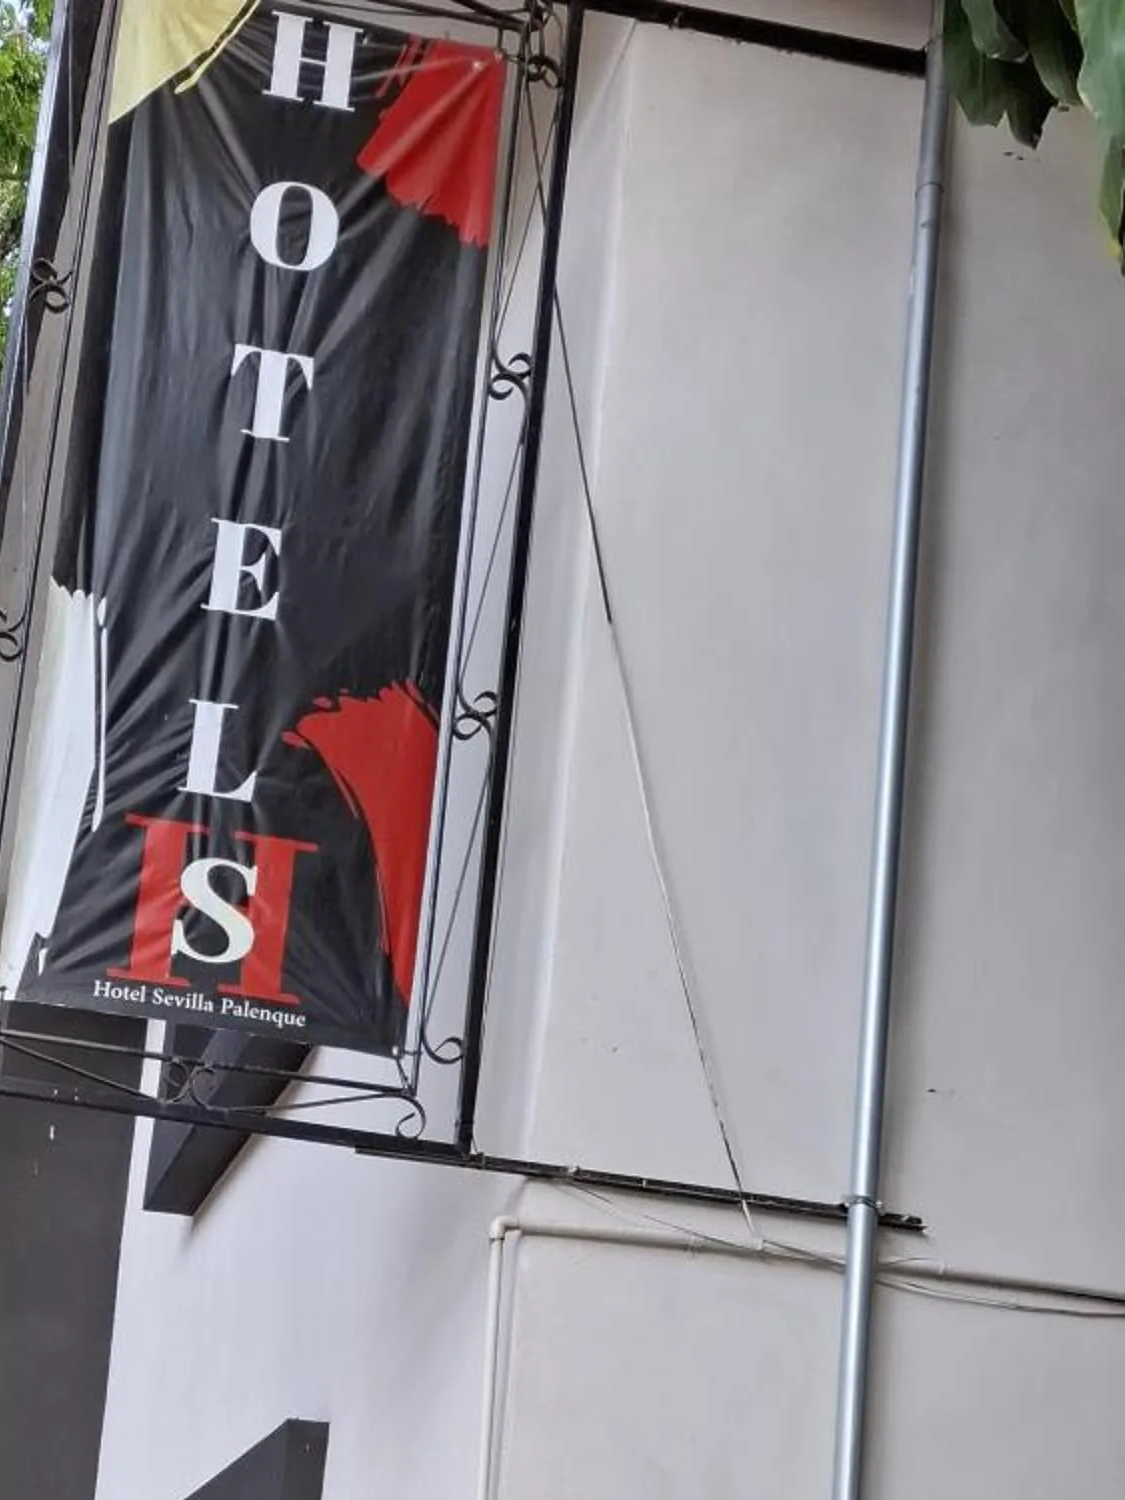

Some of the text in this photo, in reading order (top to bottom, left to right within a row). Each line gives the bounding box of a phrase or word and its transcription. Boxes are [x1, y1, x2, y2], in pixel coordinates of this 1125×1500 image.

[93, 979, 307, 1028] Hotel Sevilla Palenque
